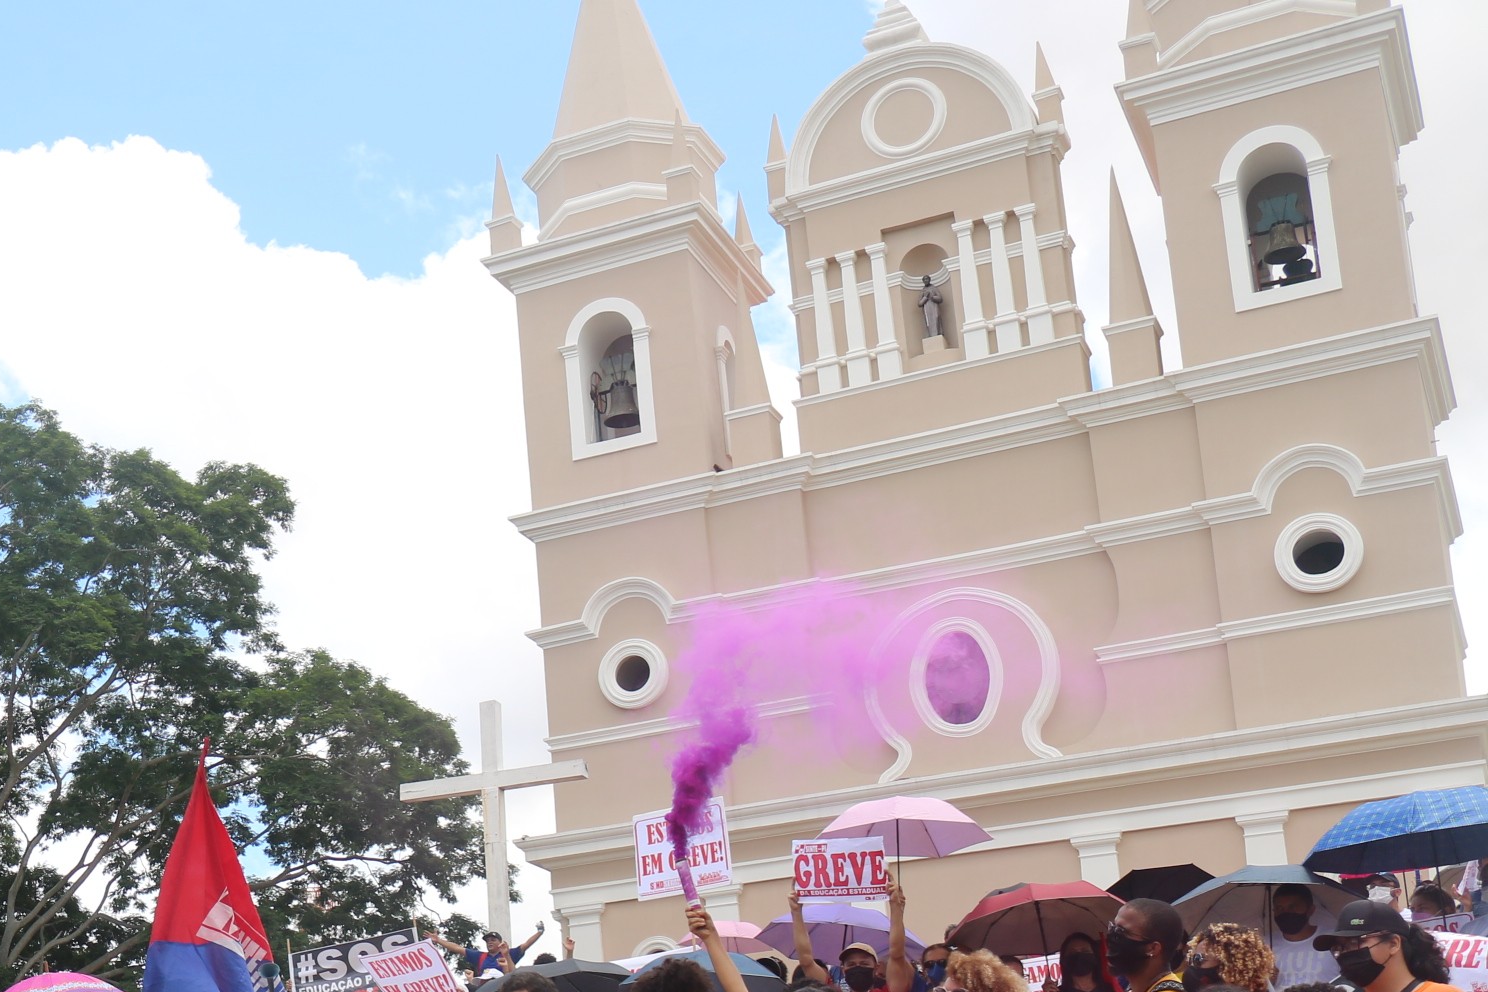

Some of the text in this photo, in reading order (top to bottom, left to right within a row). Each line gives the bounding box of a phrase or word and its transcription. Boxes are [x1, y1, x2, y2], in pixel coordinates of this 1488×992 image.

[641, 853, 663, 876] EM
[794, 850, 887, 888] GREVE
[811, 888, 847, 897] EDUCAÇÃO
[849, 887, 886, 895] ESTADUAL
[369, 948, 433, 979] ESTAMOS
